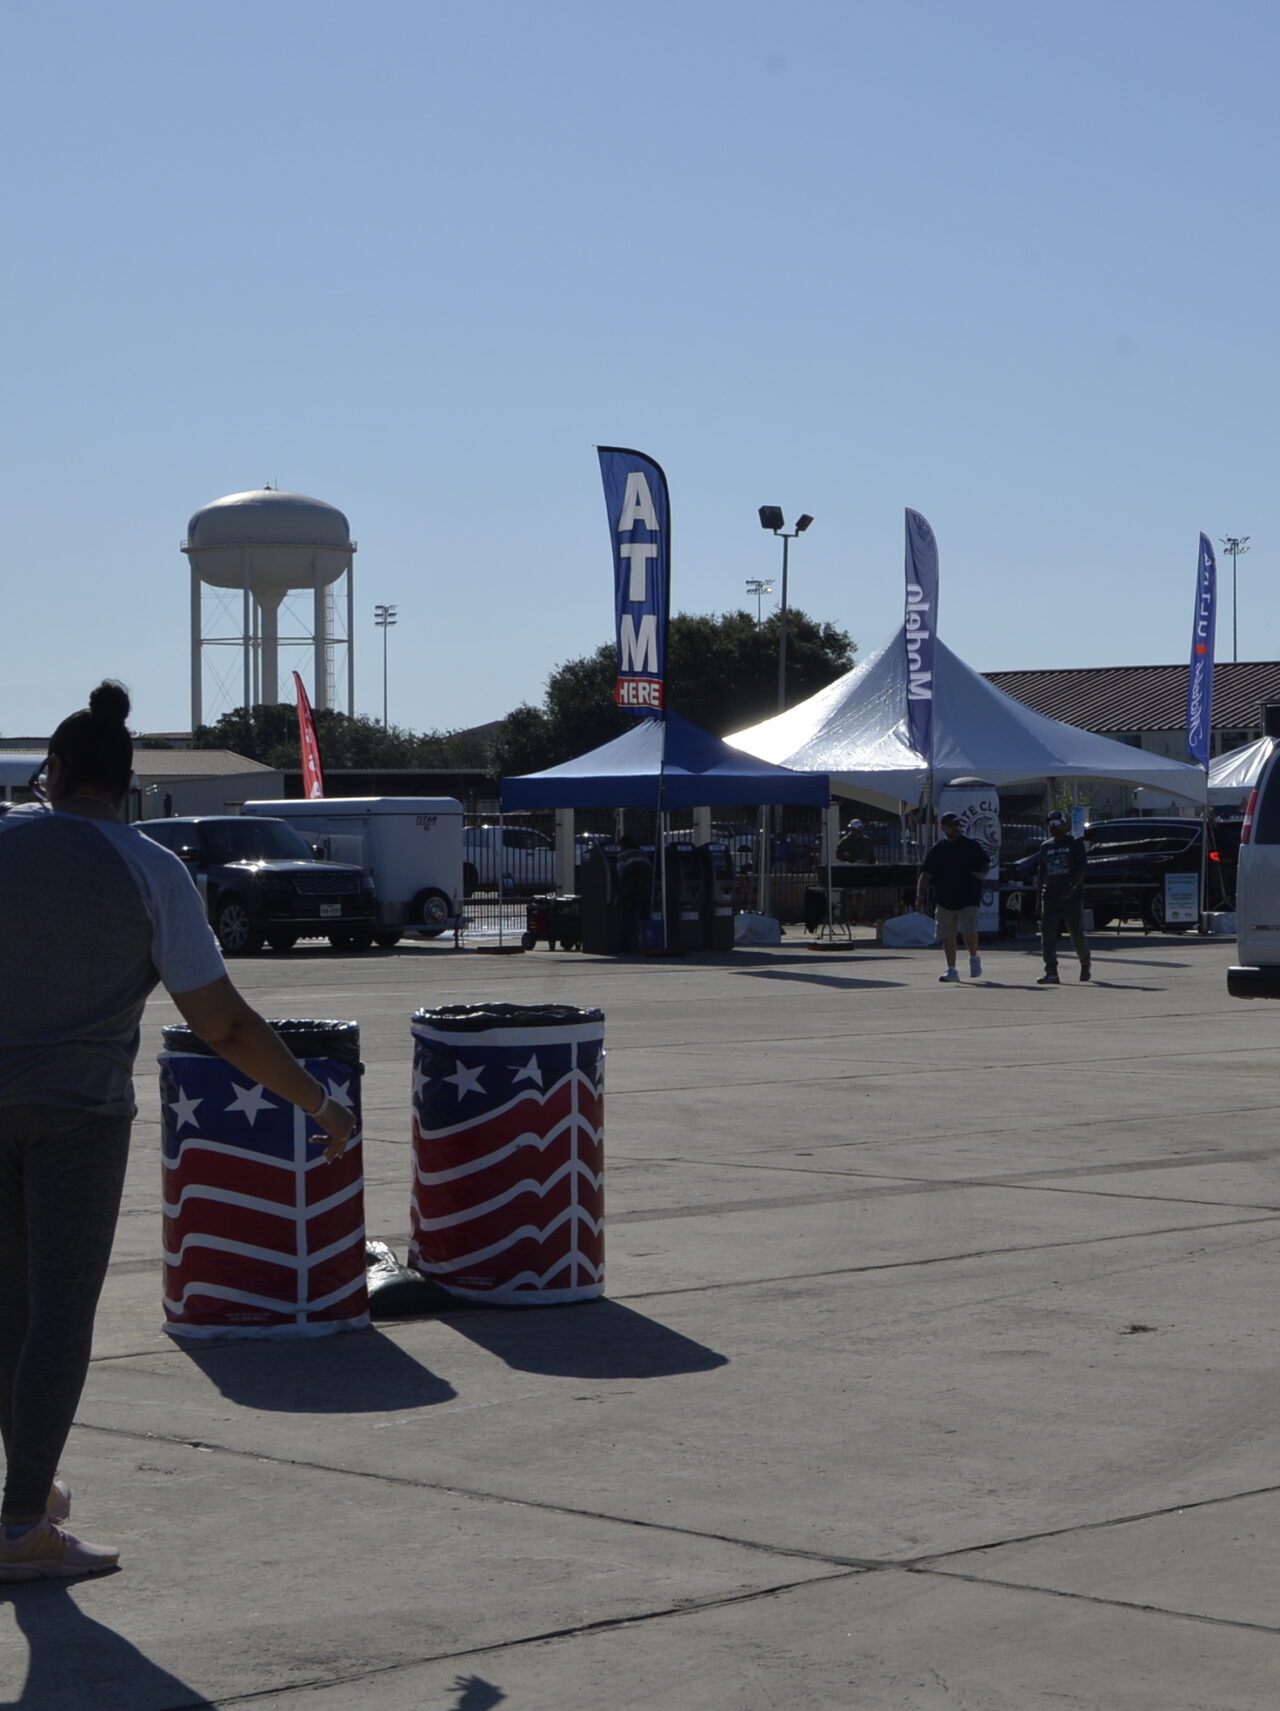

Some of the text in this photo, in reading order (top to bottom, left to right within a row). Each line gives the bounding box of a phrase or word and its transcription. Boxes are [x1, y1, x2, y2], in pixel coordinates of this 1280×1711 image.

[617, 471, 660, 673] ATM
[619, 681, 660, 706] HERE
[416, 815, 437, 824] TITAN
